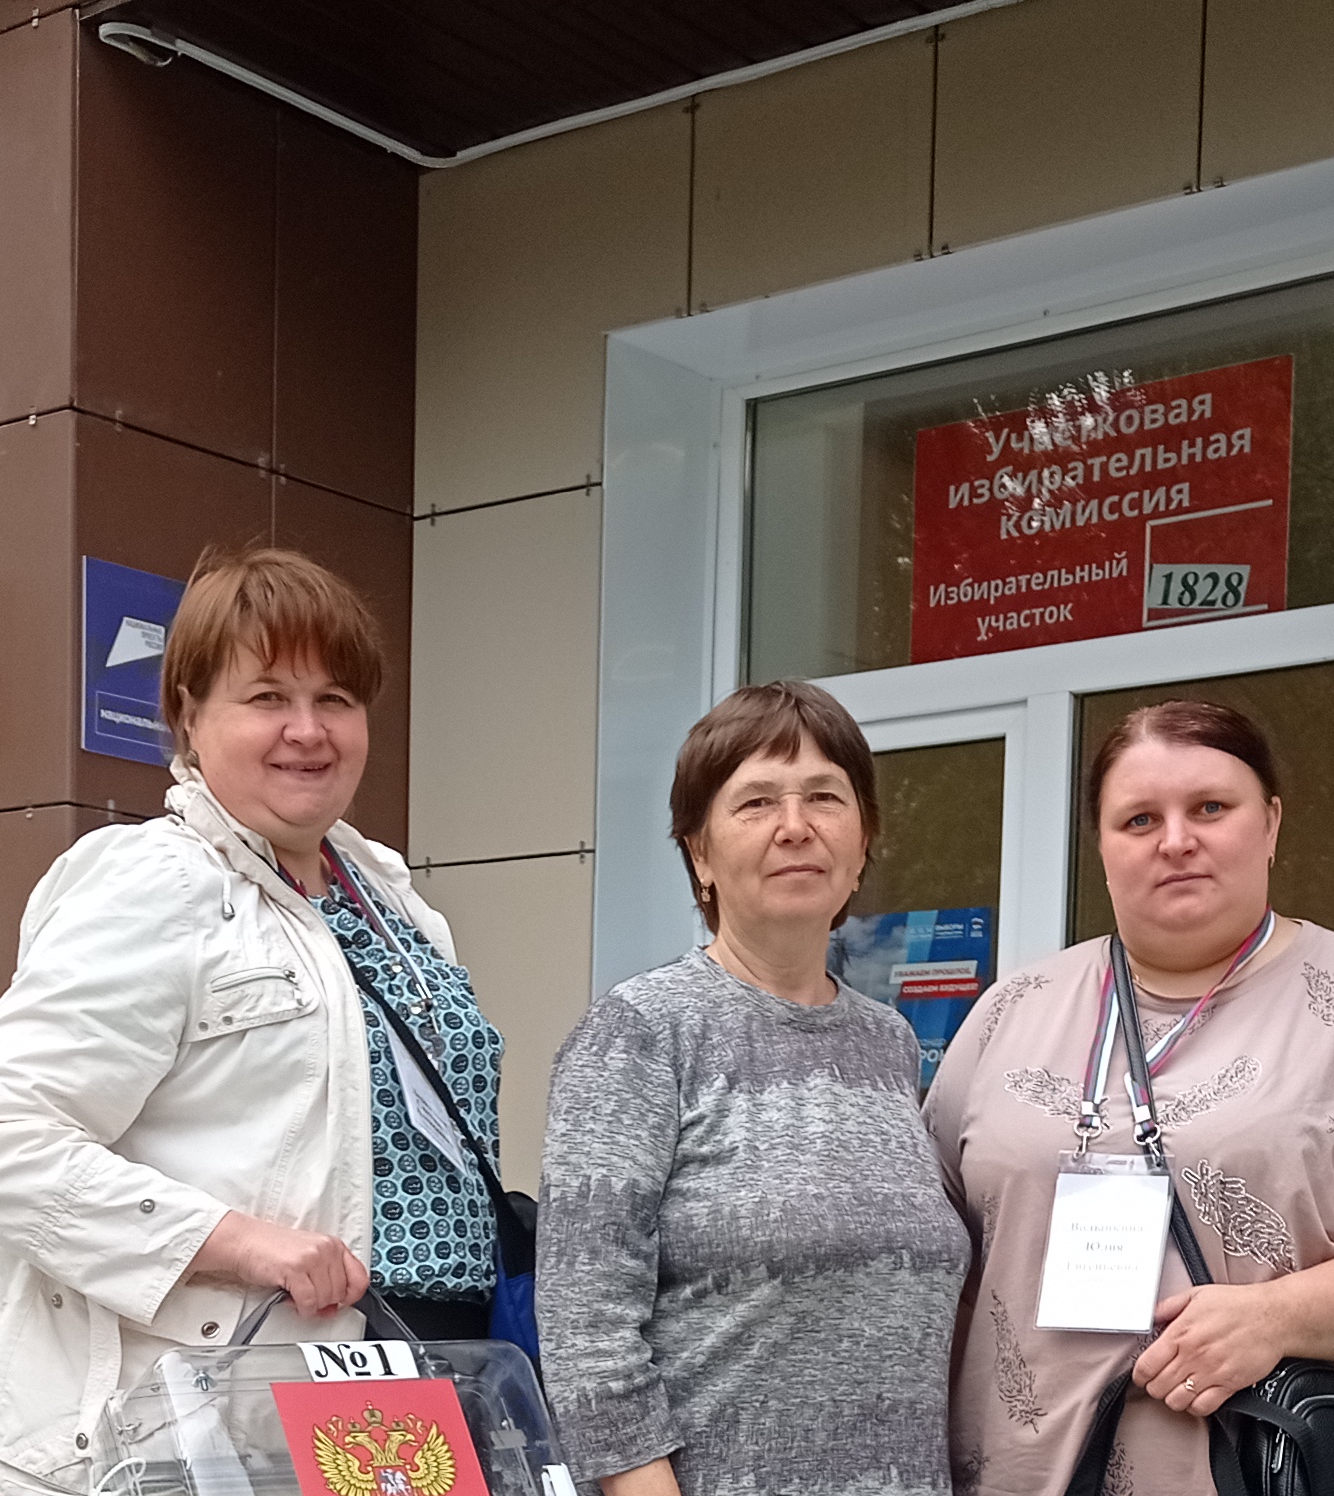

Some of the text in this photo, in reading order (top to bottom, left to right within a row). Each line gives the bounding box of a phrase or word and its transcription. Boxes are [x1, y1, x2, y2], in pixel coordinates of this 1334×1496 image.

[986, 392, 1213, 462] Участковая
[948, 427, 1253, 509] избирательная
[1000, 481, 1191, 540] комиссия
[929, 551, 1129, 608] Избирательный
[1156, 570, 1246, 609] 1828
[976, 602, 1074, 642] участок
